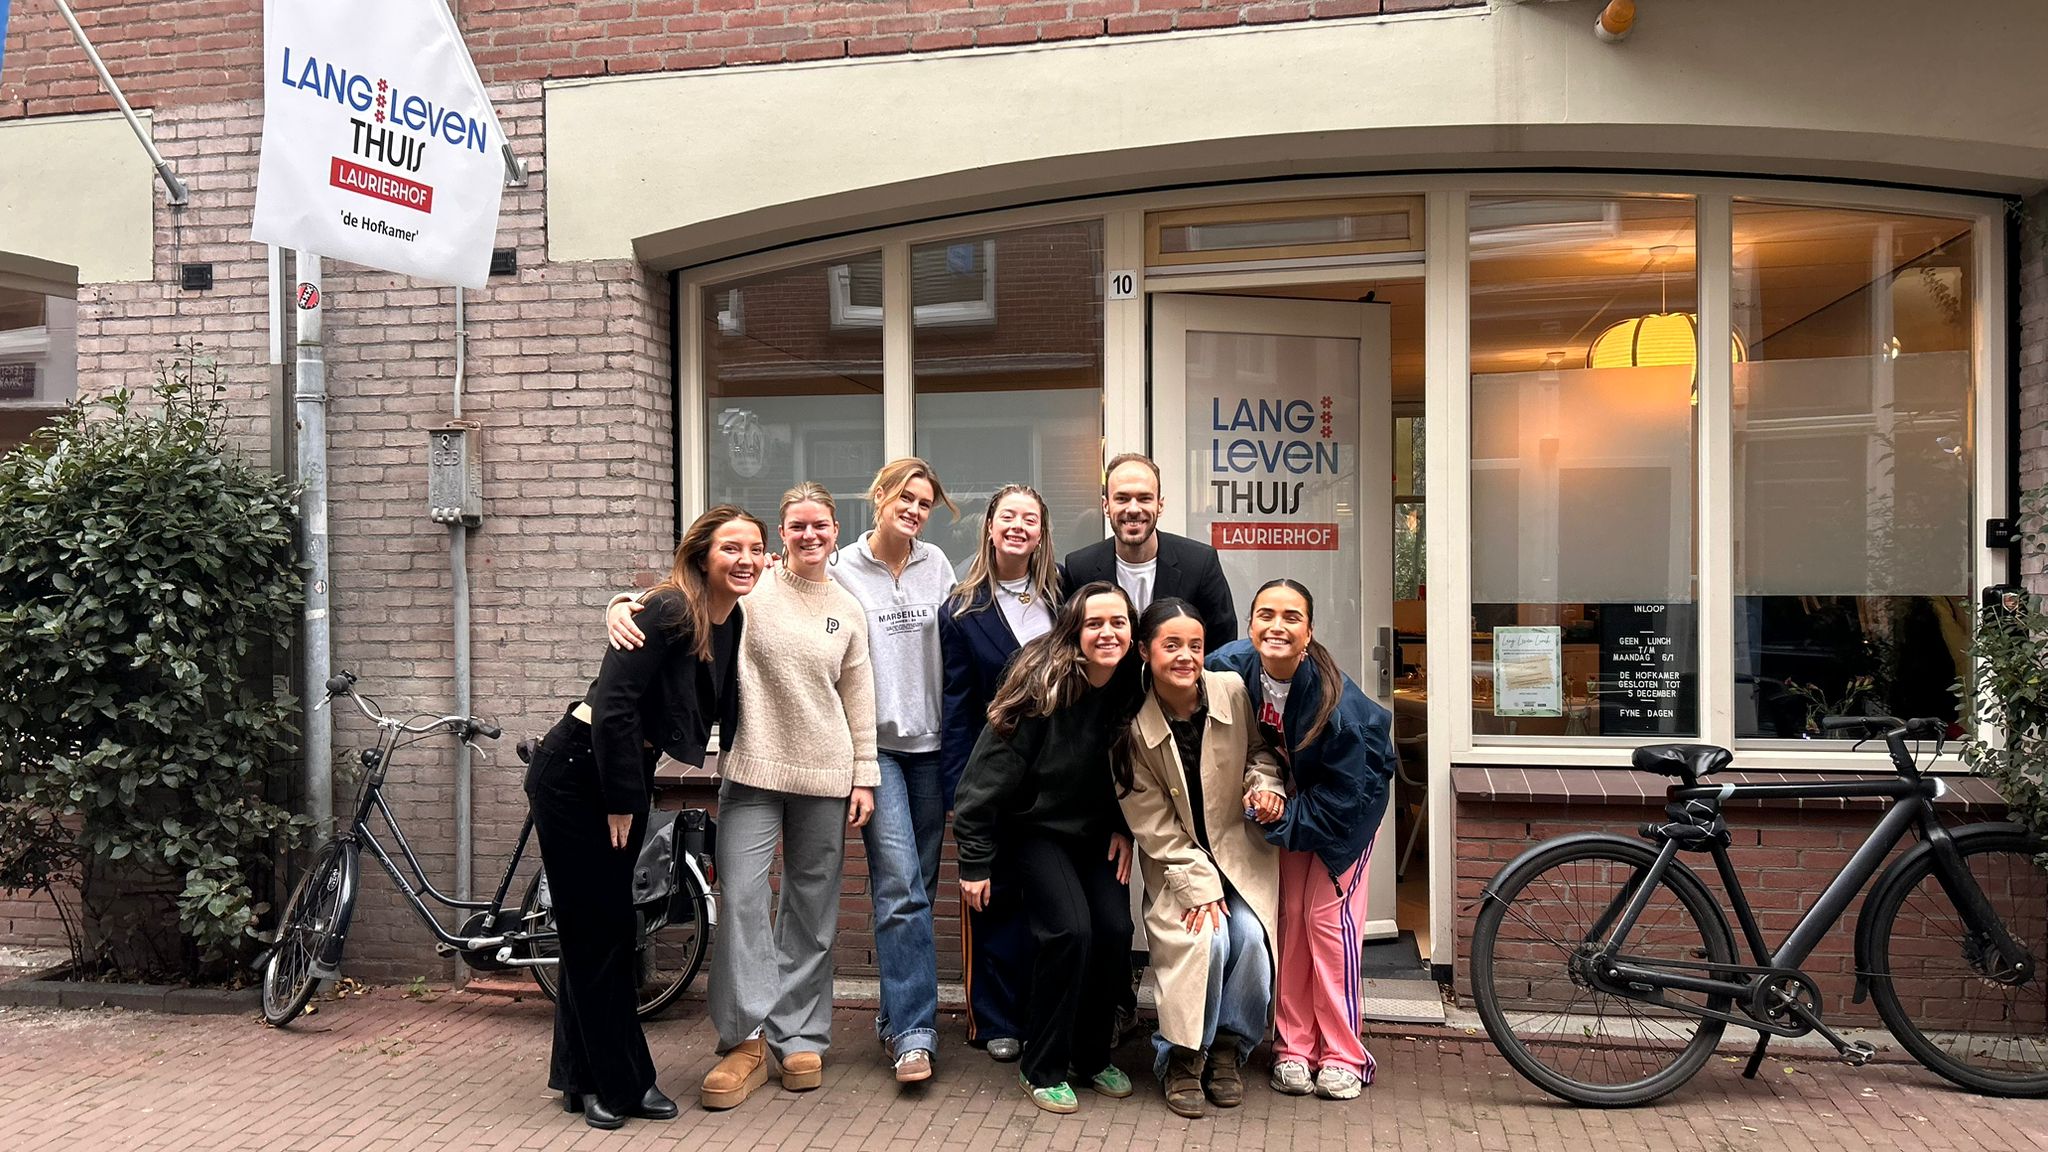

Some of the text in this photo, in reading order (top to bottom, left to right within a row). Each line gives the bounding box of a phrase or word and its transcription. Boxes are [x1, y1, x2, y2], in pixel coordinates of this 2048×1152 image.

[282, 47, 373, 111] LANG
[350, 117, 426, 172] THUIS
[338, 164, 428, 206] LAURIERHOF
[340, 210, 419, 242] 'de Hofkamer'
[1112, 274, 1133, 294] 10
[1213, 397, 1315, 433] LANG
[1211, 480, 1304, 514] THUIS
[1222, 528, 1331, 546] LAURIERHOF
[878, 609, 928, 623] MARSEILLE
[1634, 605, 1665, 613] INLOOP
[826, 617, 840, 634] P
[1619, 637, 1671, 645] GEEN LUNCH
[1612, 653, 1674, 661] MAANDAG 6/1
[1638, 646, 1656, 654] T/M
[1619, 671, 1680, 679] DE HOFKAMER
[1618, 680, 1681, 689] GESLOTEN TOT
[1627, 689, 1677, 698] 5 DECEMBER
[1619, 709, 1674, 717] FYNE DAGEN
